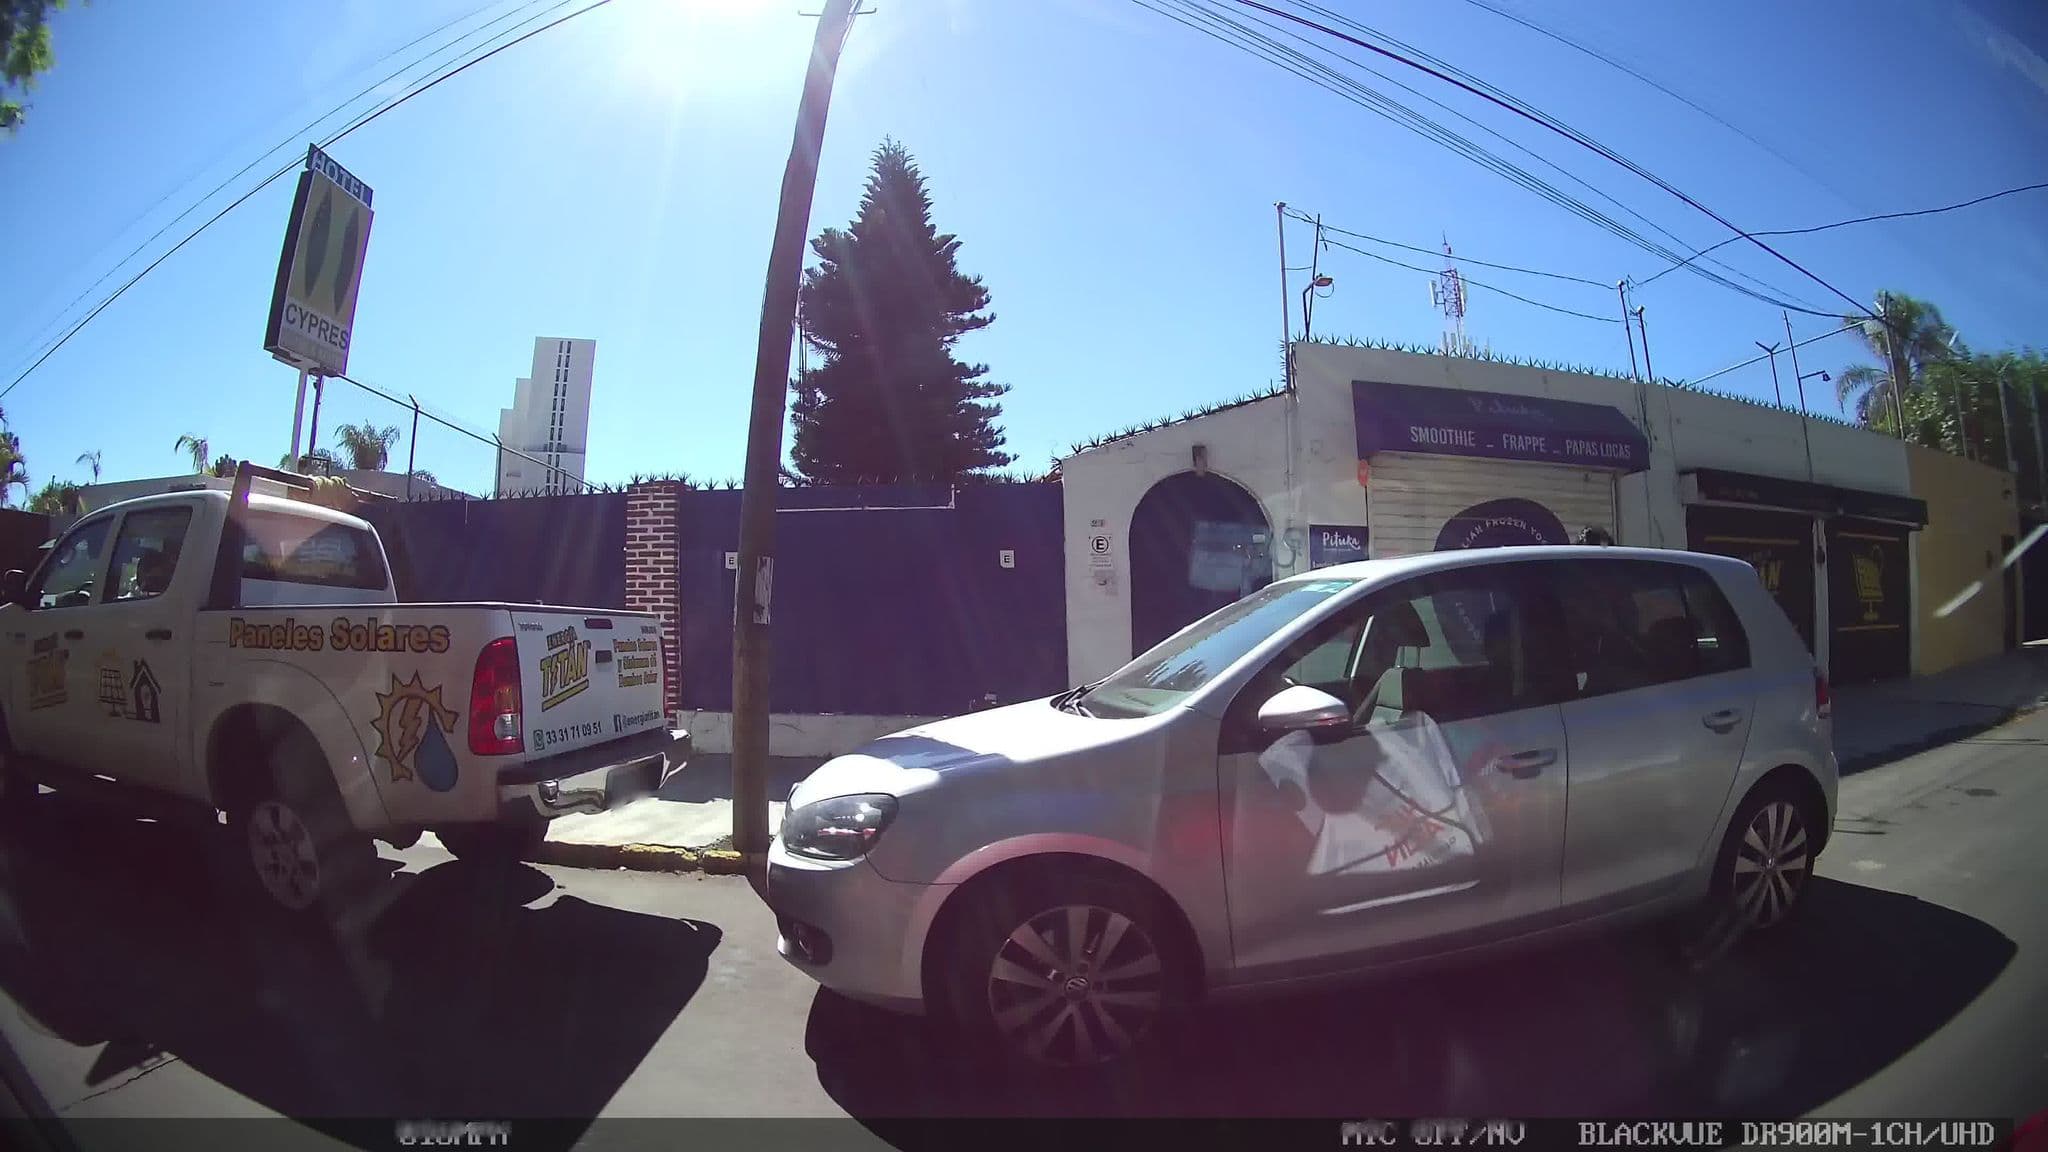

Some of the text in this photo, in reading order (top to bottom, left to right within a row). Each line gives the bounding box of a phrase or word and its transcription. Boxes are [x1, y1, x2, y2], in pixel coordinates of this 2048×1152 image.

[285, 302, 350, 350] CYPRES
[1409, 425, 1476, 448] SMOOTHIE
[1502, 432, 1546, 453] FRAPPE
[1565, 439, 1599, 457] PAPAS
[1600, 442, 1631, 459] LOCAS
[1485, 517, 1527, 530] FROZEN
[1096, 538, 1105, 550] E
[1322, 531, 1361, 550] Pituka
[229, 616, 452, 654] Paneles Solares
[545, 720, 602, 745] 33 31 71 09 51
